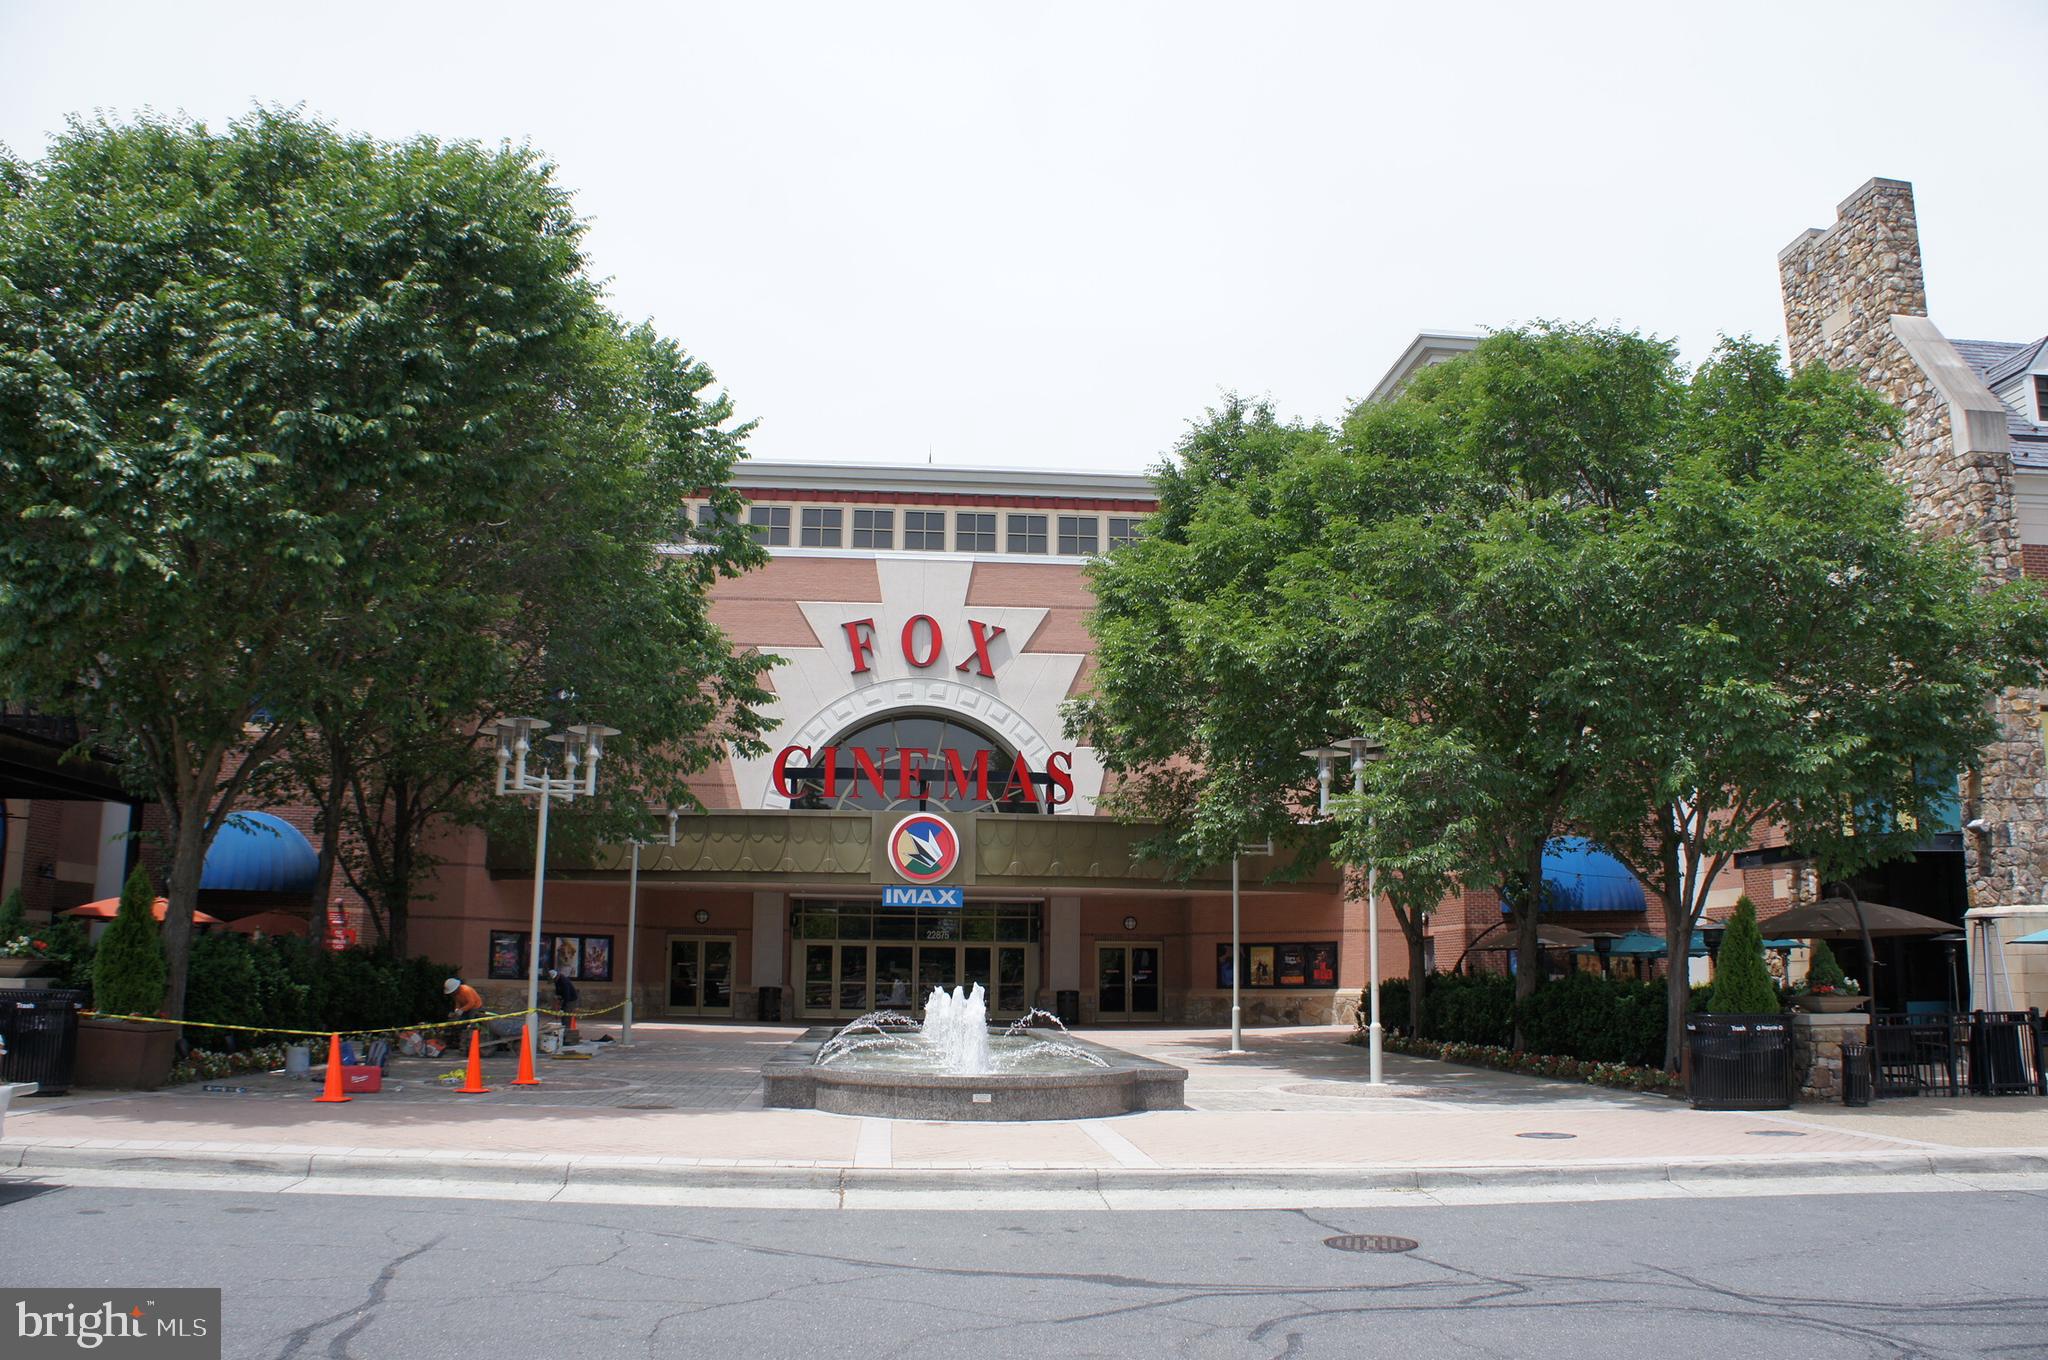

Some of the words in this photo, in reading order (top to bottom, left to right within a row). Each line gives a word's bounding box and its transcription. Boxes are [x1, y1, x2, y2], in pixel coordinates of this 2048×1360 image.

[841, 614, 1006, 679] FOX
[772, 744, 1074, 805] CINEMAS
[885, 888, 957, 905] IMAX
[926, 930, 950, 940] 22875
